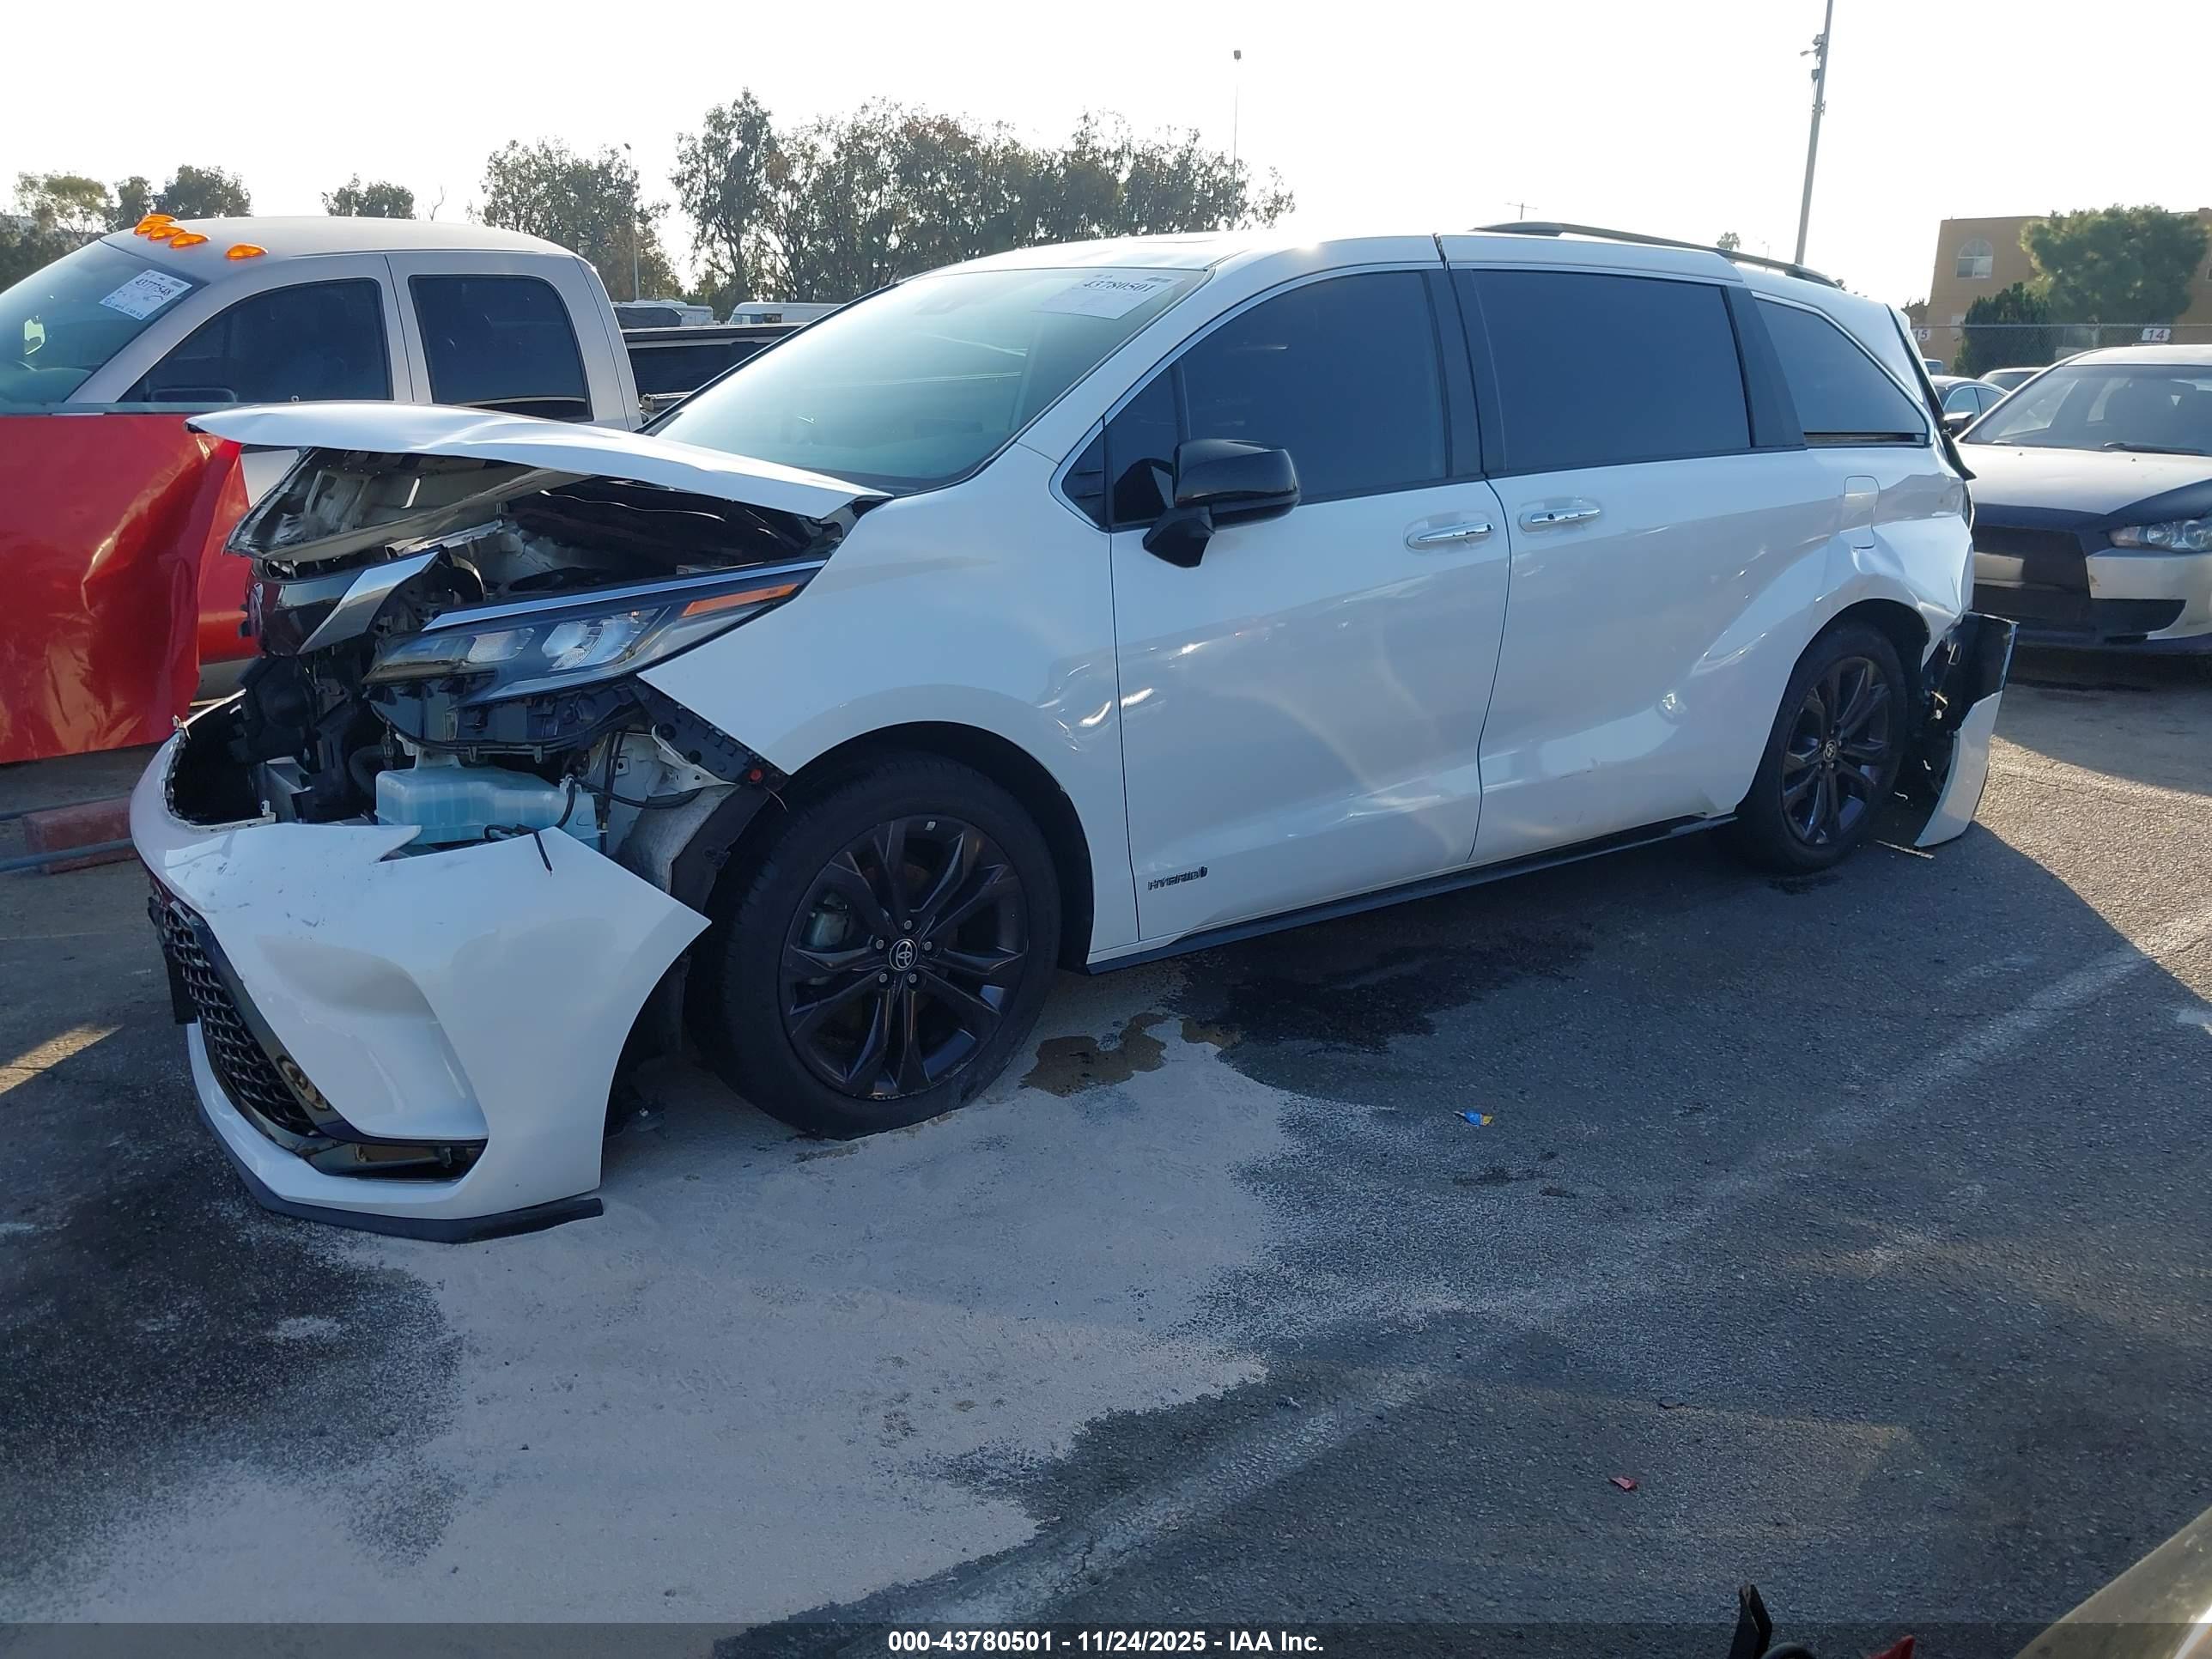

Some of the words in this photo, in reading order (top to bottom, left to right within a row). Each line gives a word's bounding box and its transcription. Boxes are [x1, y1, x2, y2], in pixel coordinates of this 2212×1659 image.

[1084, 280, 1157, 293] 43780501
[2149, 329, 2166, 340] 14
[1147, 870, 1200, 890] HYBRID
